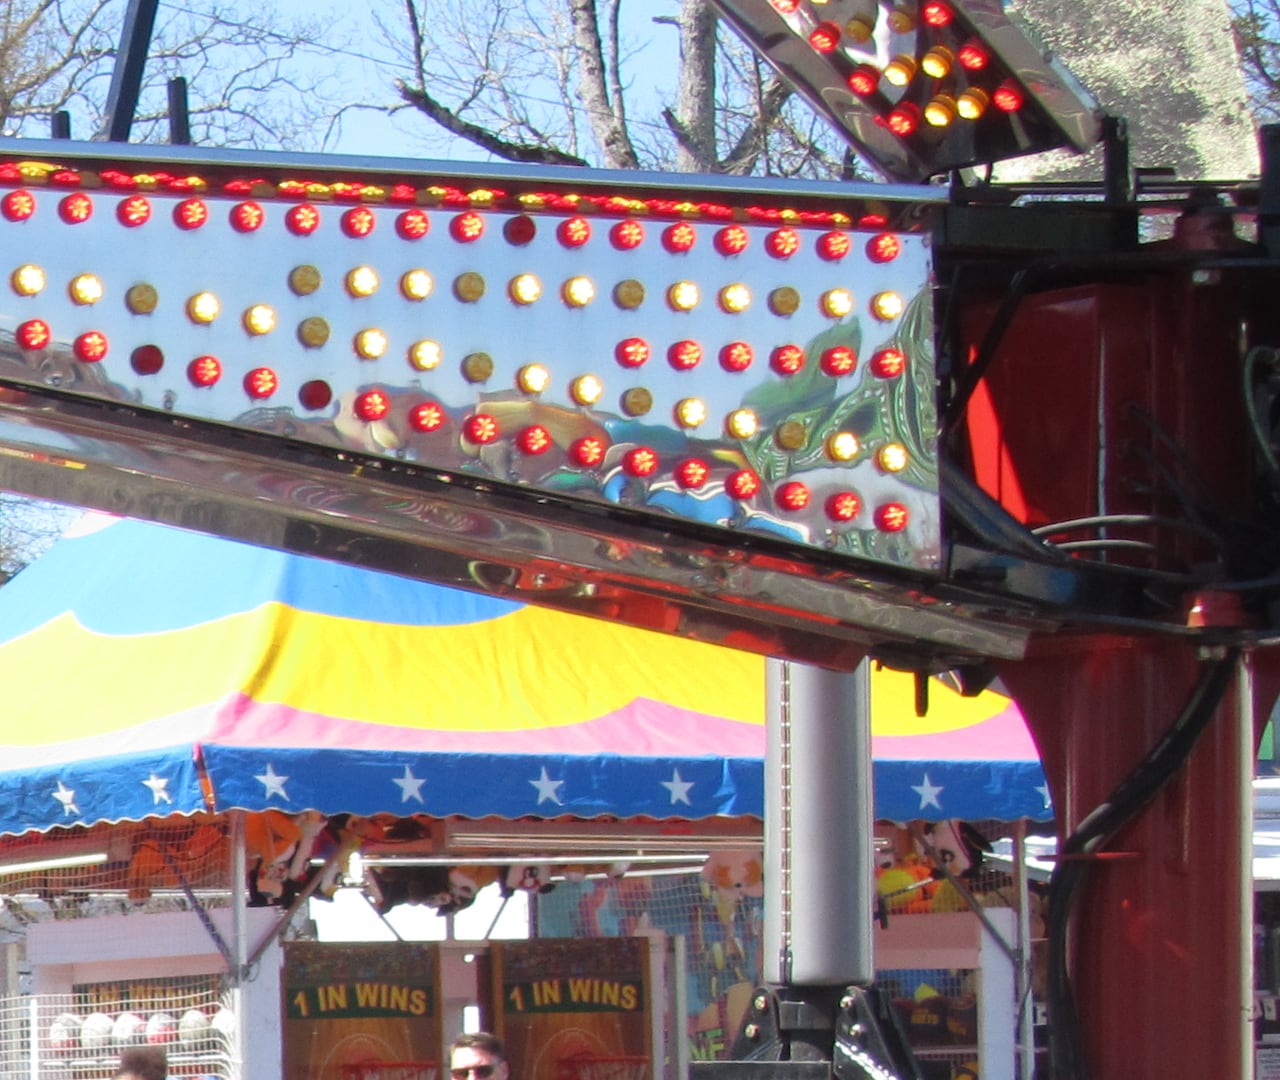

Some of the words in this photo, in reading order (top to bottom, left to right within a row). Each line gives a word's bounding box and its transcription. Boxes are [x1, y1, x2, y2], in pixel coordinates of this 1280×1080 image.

[294, 991, 309, 1017] 1
[317, 984, 348, 1011] IN
[355, 983, 427, 1015] WINS
[509, 985, 523, 1011] 1
[532, 979, 560, 1006] IN
[568, 978, 637, 1010] WINS
